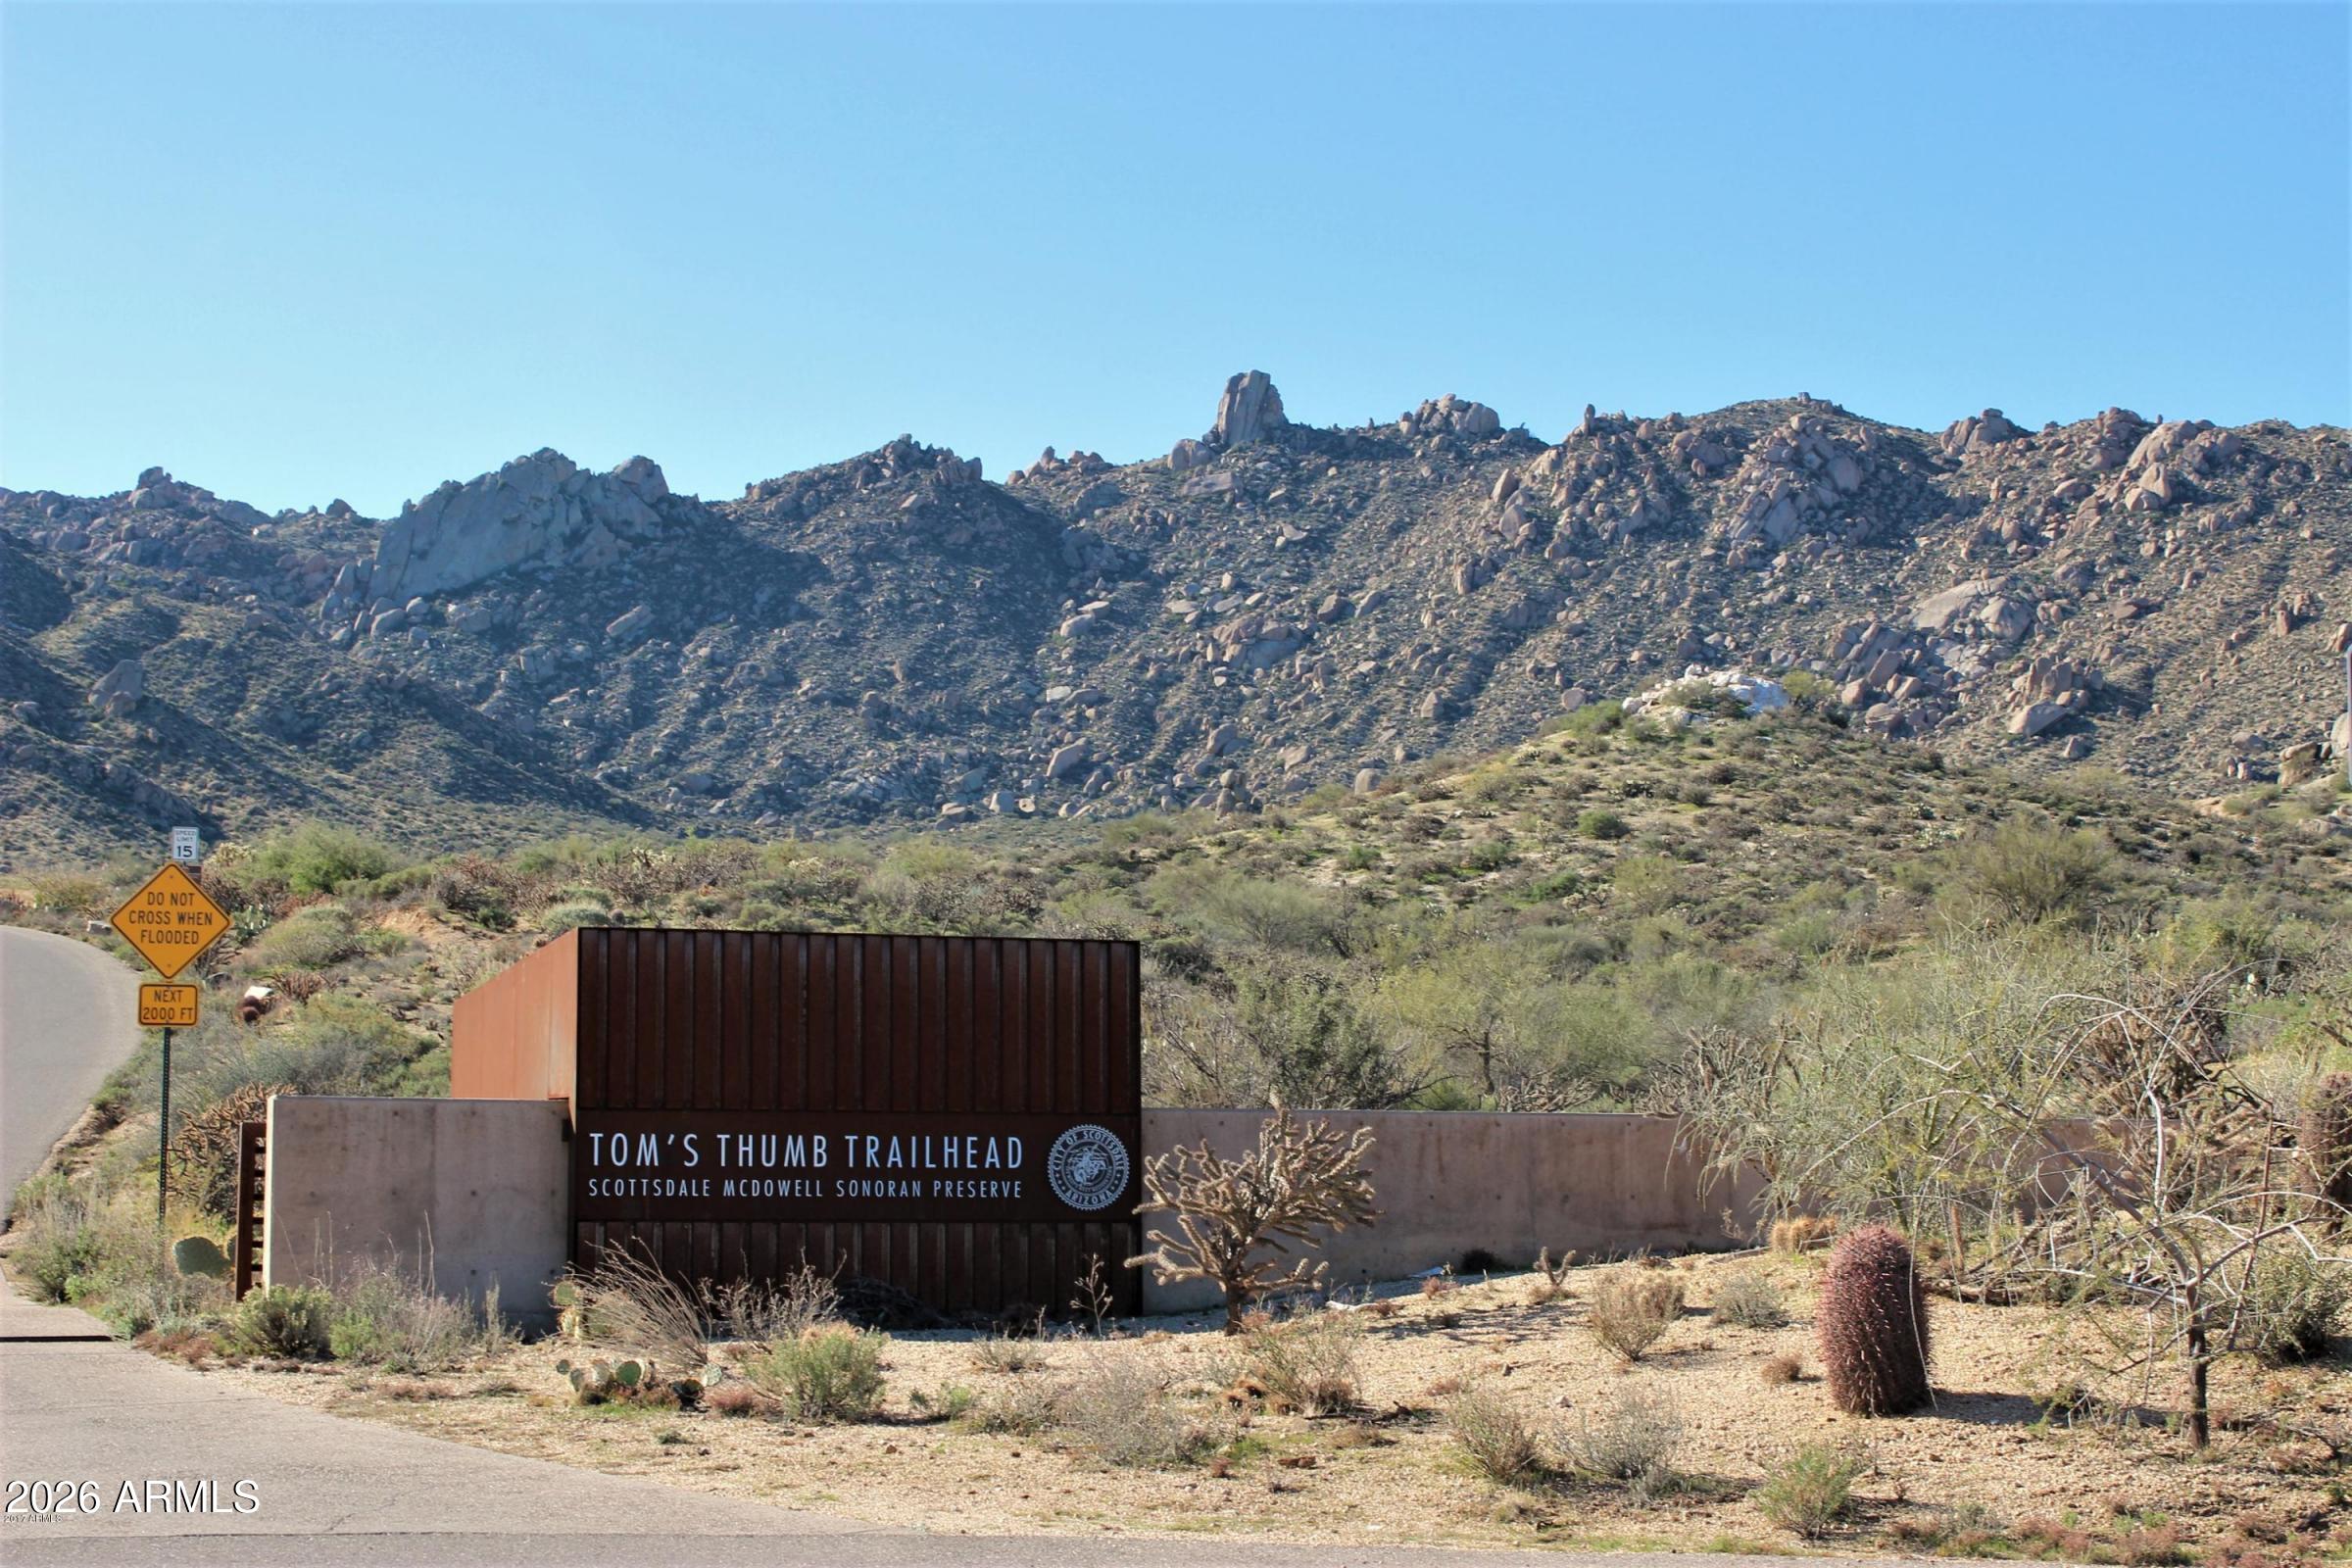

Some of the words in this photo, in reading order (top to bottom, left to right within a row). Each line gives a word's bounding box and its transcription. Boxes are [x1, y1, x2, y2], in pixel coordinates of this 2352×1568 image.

[176, 845, 193, 858] 15
[147, 892, 164, 906] DO
[171, 893, 195, 906] NOT
[128, 910, 171, 924] CROSS
[177, 911, 213, 925] WHEN
[140, 929, 199, 945] FLOODED
[154, 990, 183, 1003] NEXT
[143, 1007, 174, 1020] 2000
[180, 1007, 193, 1020] FT
[589, 1133, 699, 1167] TOM'S
[716, 1134, 828, 1168] THUMB
[845, 1135, 1022, 1169] TRAILHEAD
[1054, 1145, 1067, 1171] CITY
[1066, 1133, 1079, 1146] OF
[1083, 1130, 1125, 1170] SCOTTSDALE
[589, 1179, 710, 1197] SCOTTSDALE
[723, 1179, 823, 1198] MCDOWELL
[836, 1180, 921, 1198] SONORAN
[934, 1180, 1021, 1199] PRESERVE
[1065, 1189, 1114, 1205] ARIZONA
